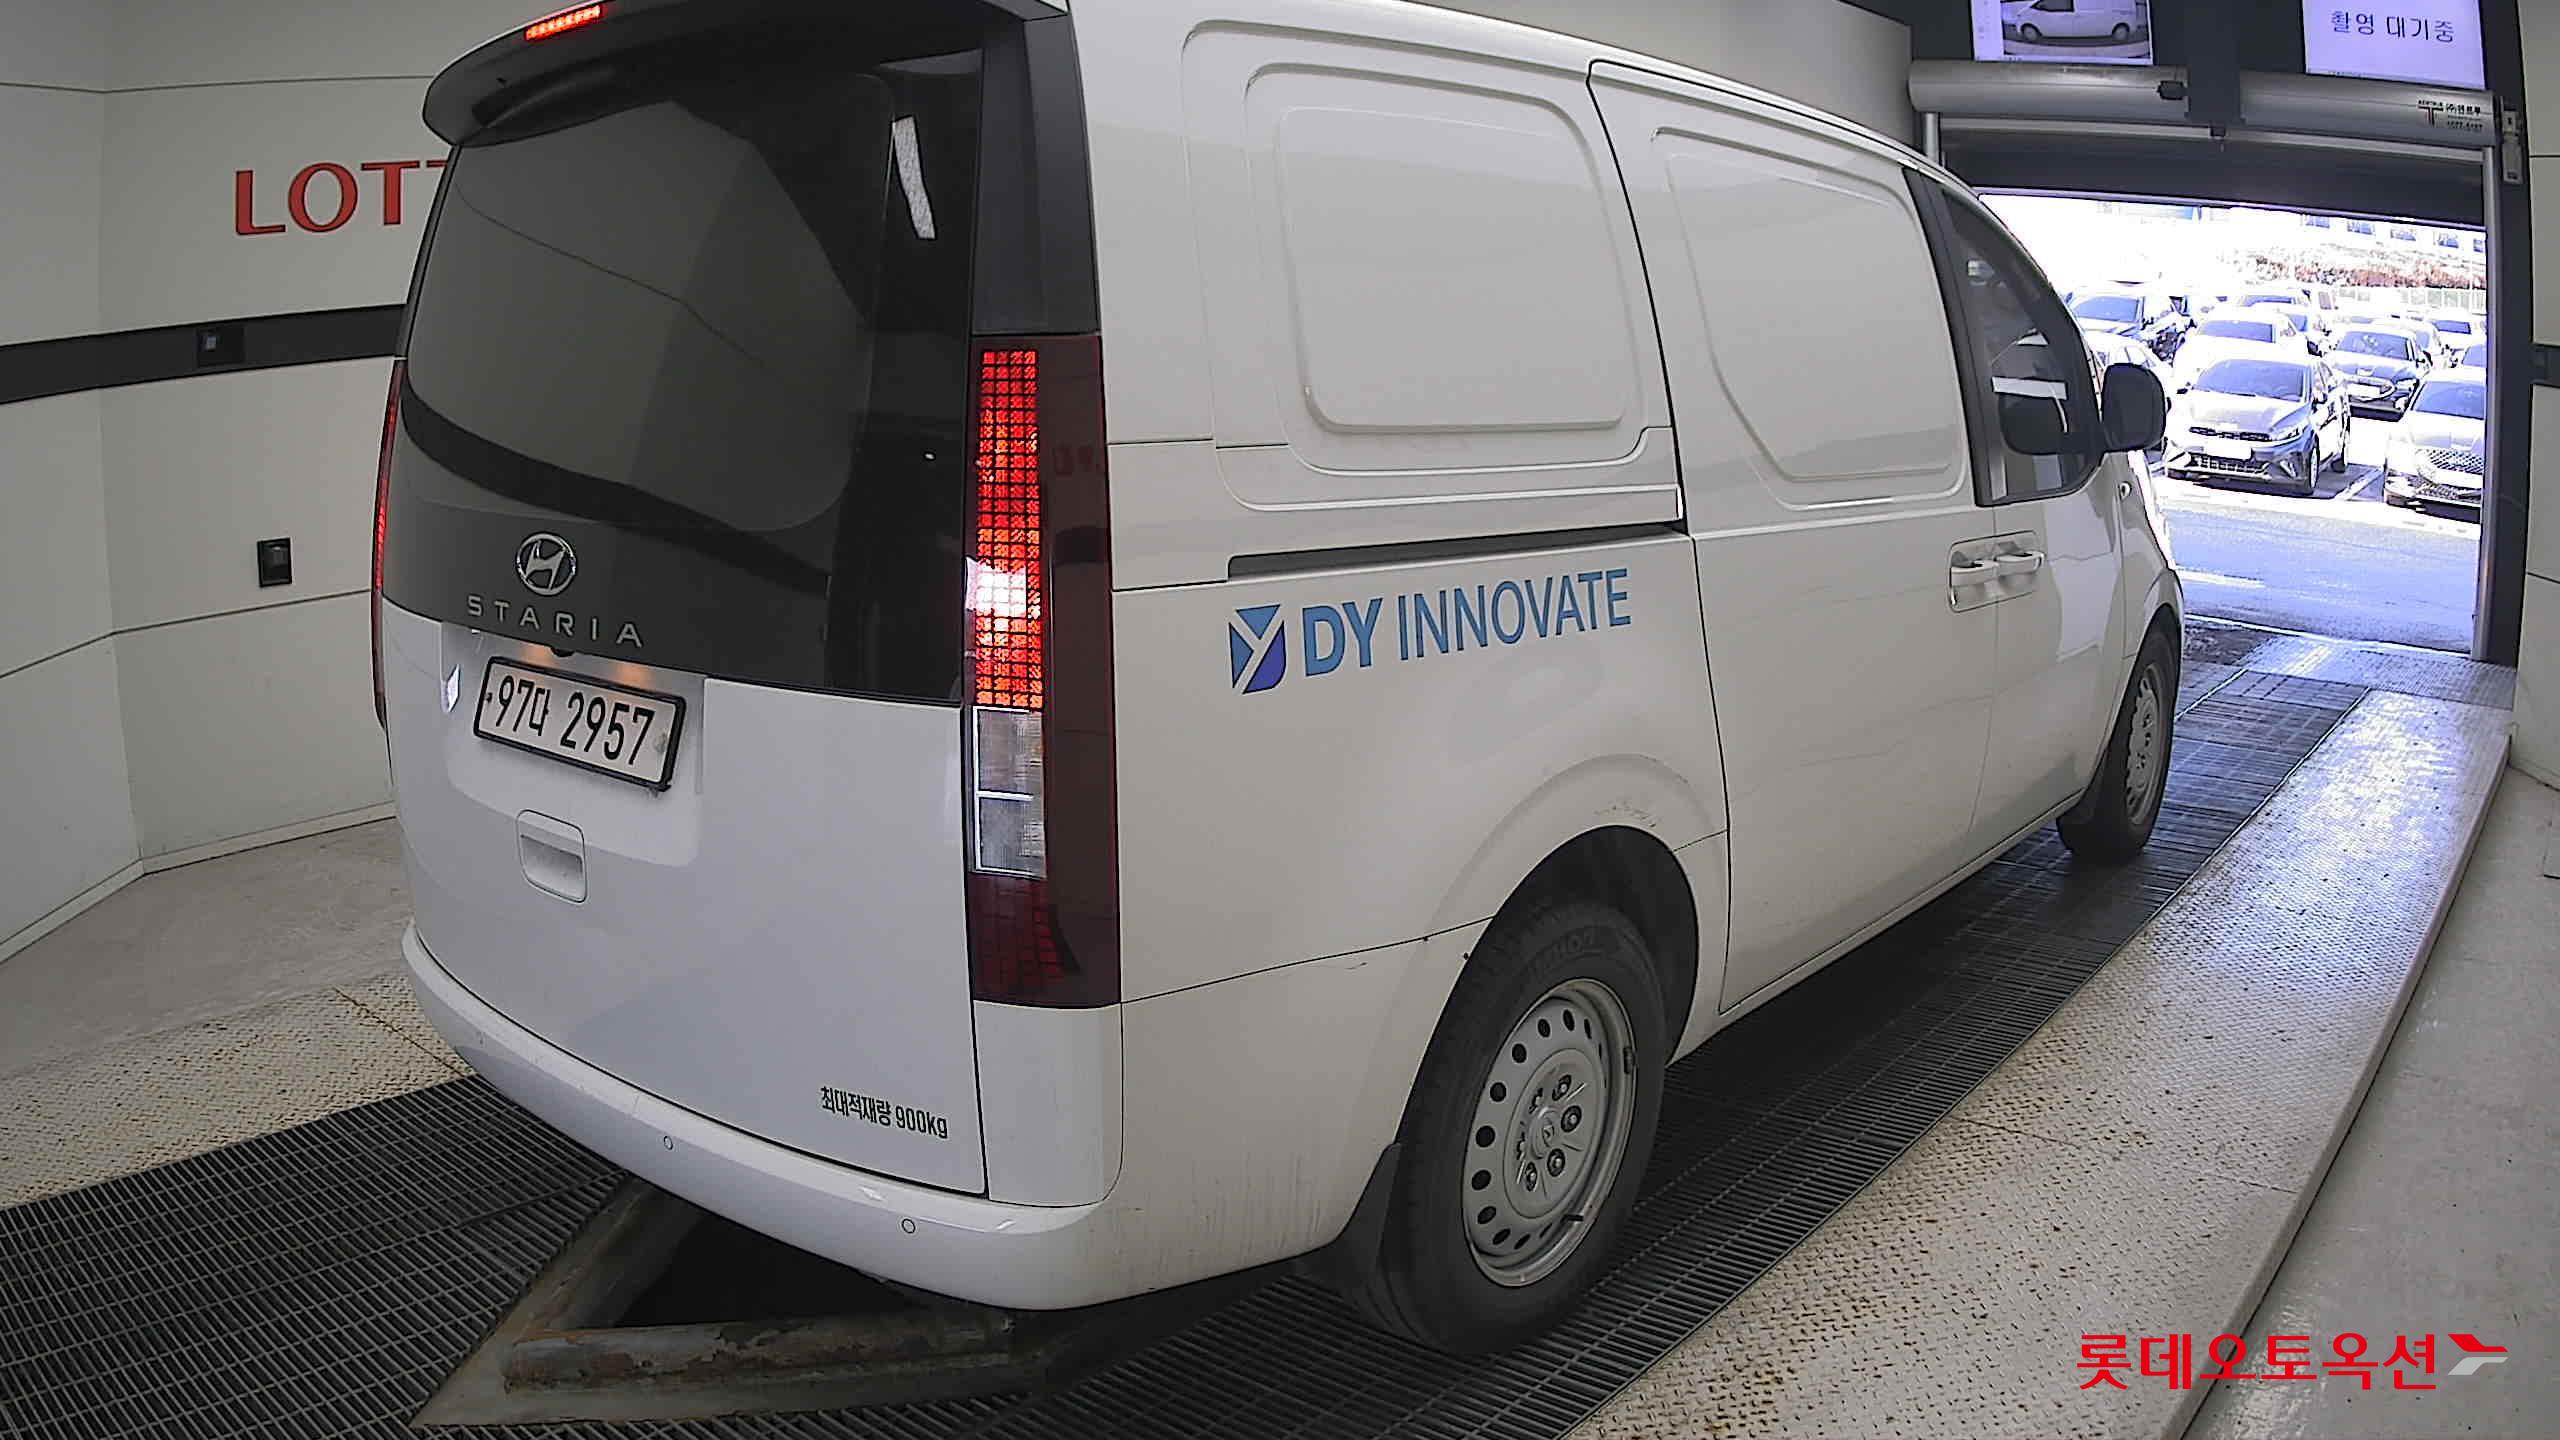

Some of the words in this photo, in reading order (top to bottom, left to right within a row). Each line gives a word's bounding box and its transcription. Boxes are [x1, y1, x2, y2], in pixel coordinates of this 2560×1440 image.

[2330, 10, 2375, 35] 촬영
[2386, 15, 2456, 43] 대기중
[235, 160, 448, 236] LOT
[466, 595, 642, 648] STARIA
[1302, 598, 1383, 677] DY
[1399, 568, 1631, 660] INNOVATE
[495, 674, 551, 737] 97다
[559, 692, 656, 766] 2957
[820, 1086, 892, 1127] 최대적재량
[895, 1105, 948, 1139] 900kg
